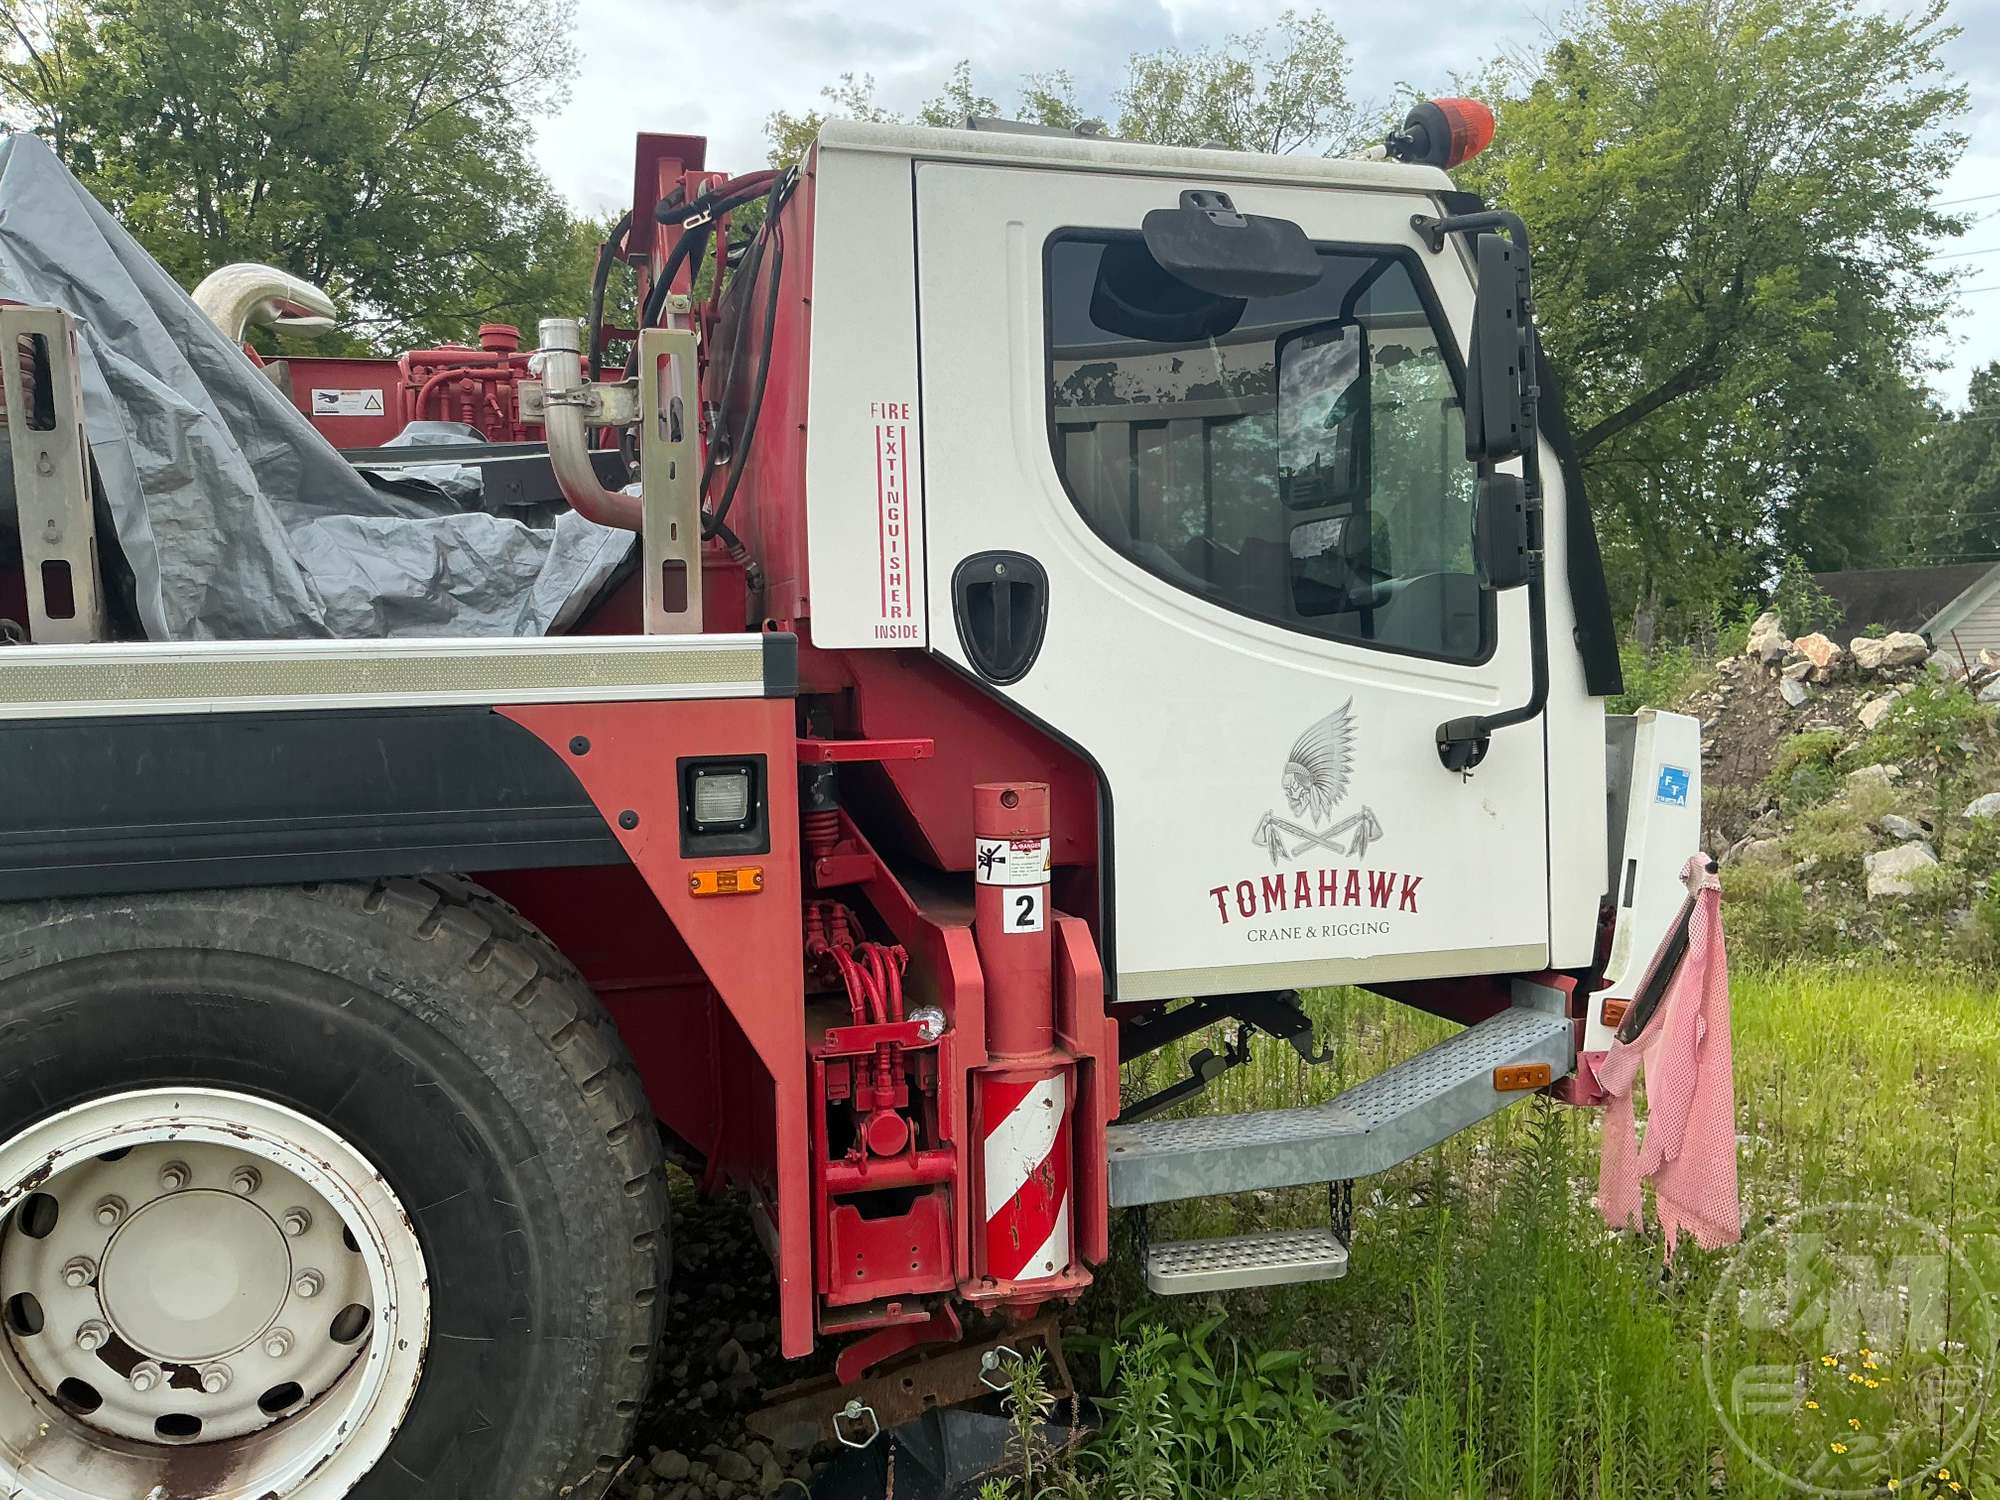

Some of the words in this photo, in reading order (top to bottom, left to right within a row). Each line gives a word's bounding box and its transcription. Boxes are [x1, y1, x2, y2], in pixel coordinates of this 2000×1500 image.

[870, 402, 910, 420] FIRE
[886, 425, 903, 618] EXTINGUISHER
[875, 625, 918, 640] INSIDE
[1209, 869, 1424, 924] TOMAHAWK
[1015, 895, 1035, 926] 2
[1247, 926, 1302, 942] CRANE
[1305, 926, 1318, 938] &
[1322, 921, 1391, 937] RIGGING
